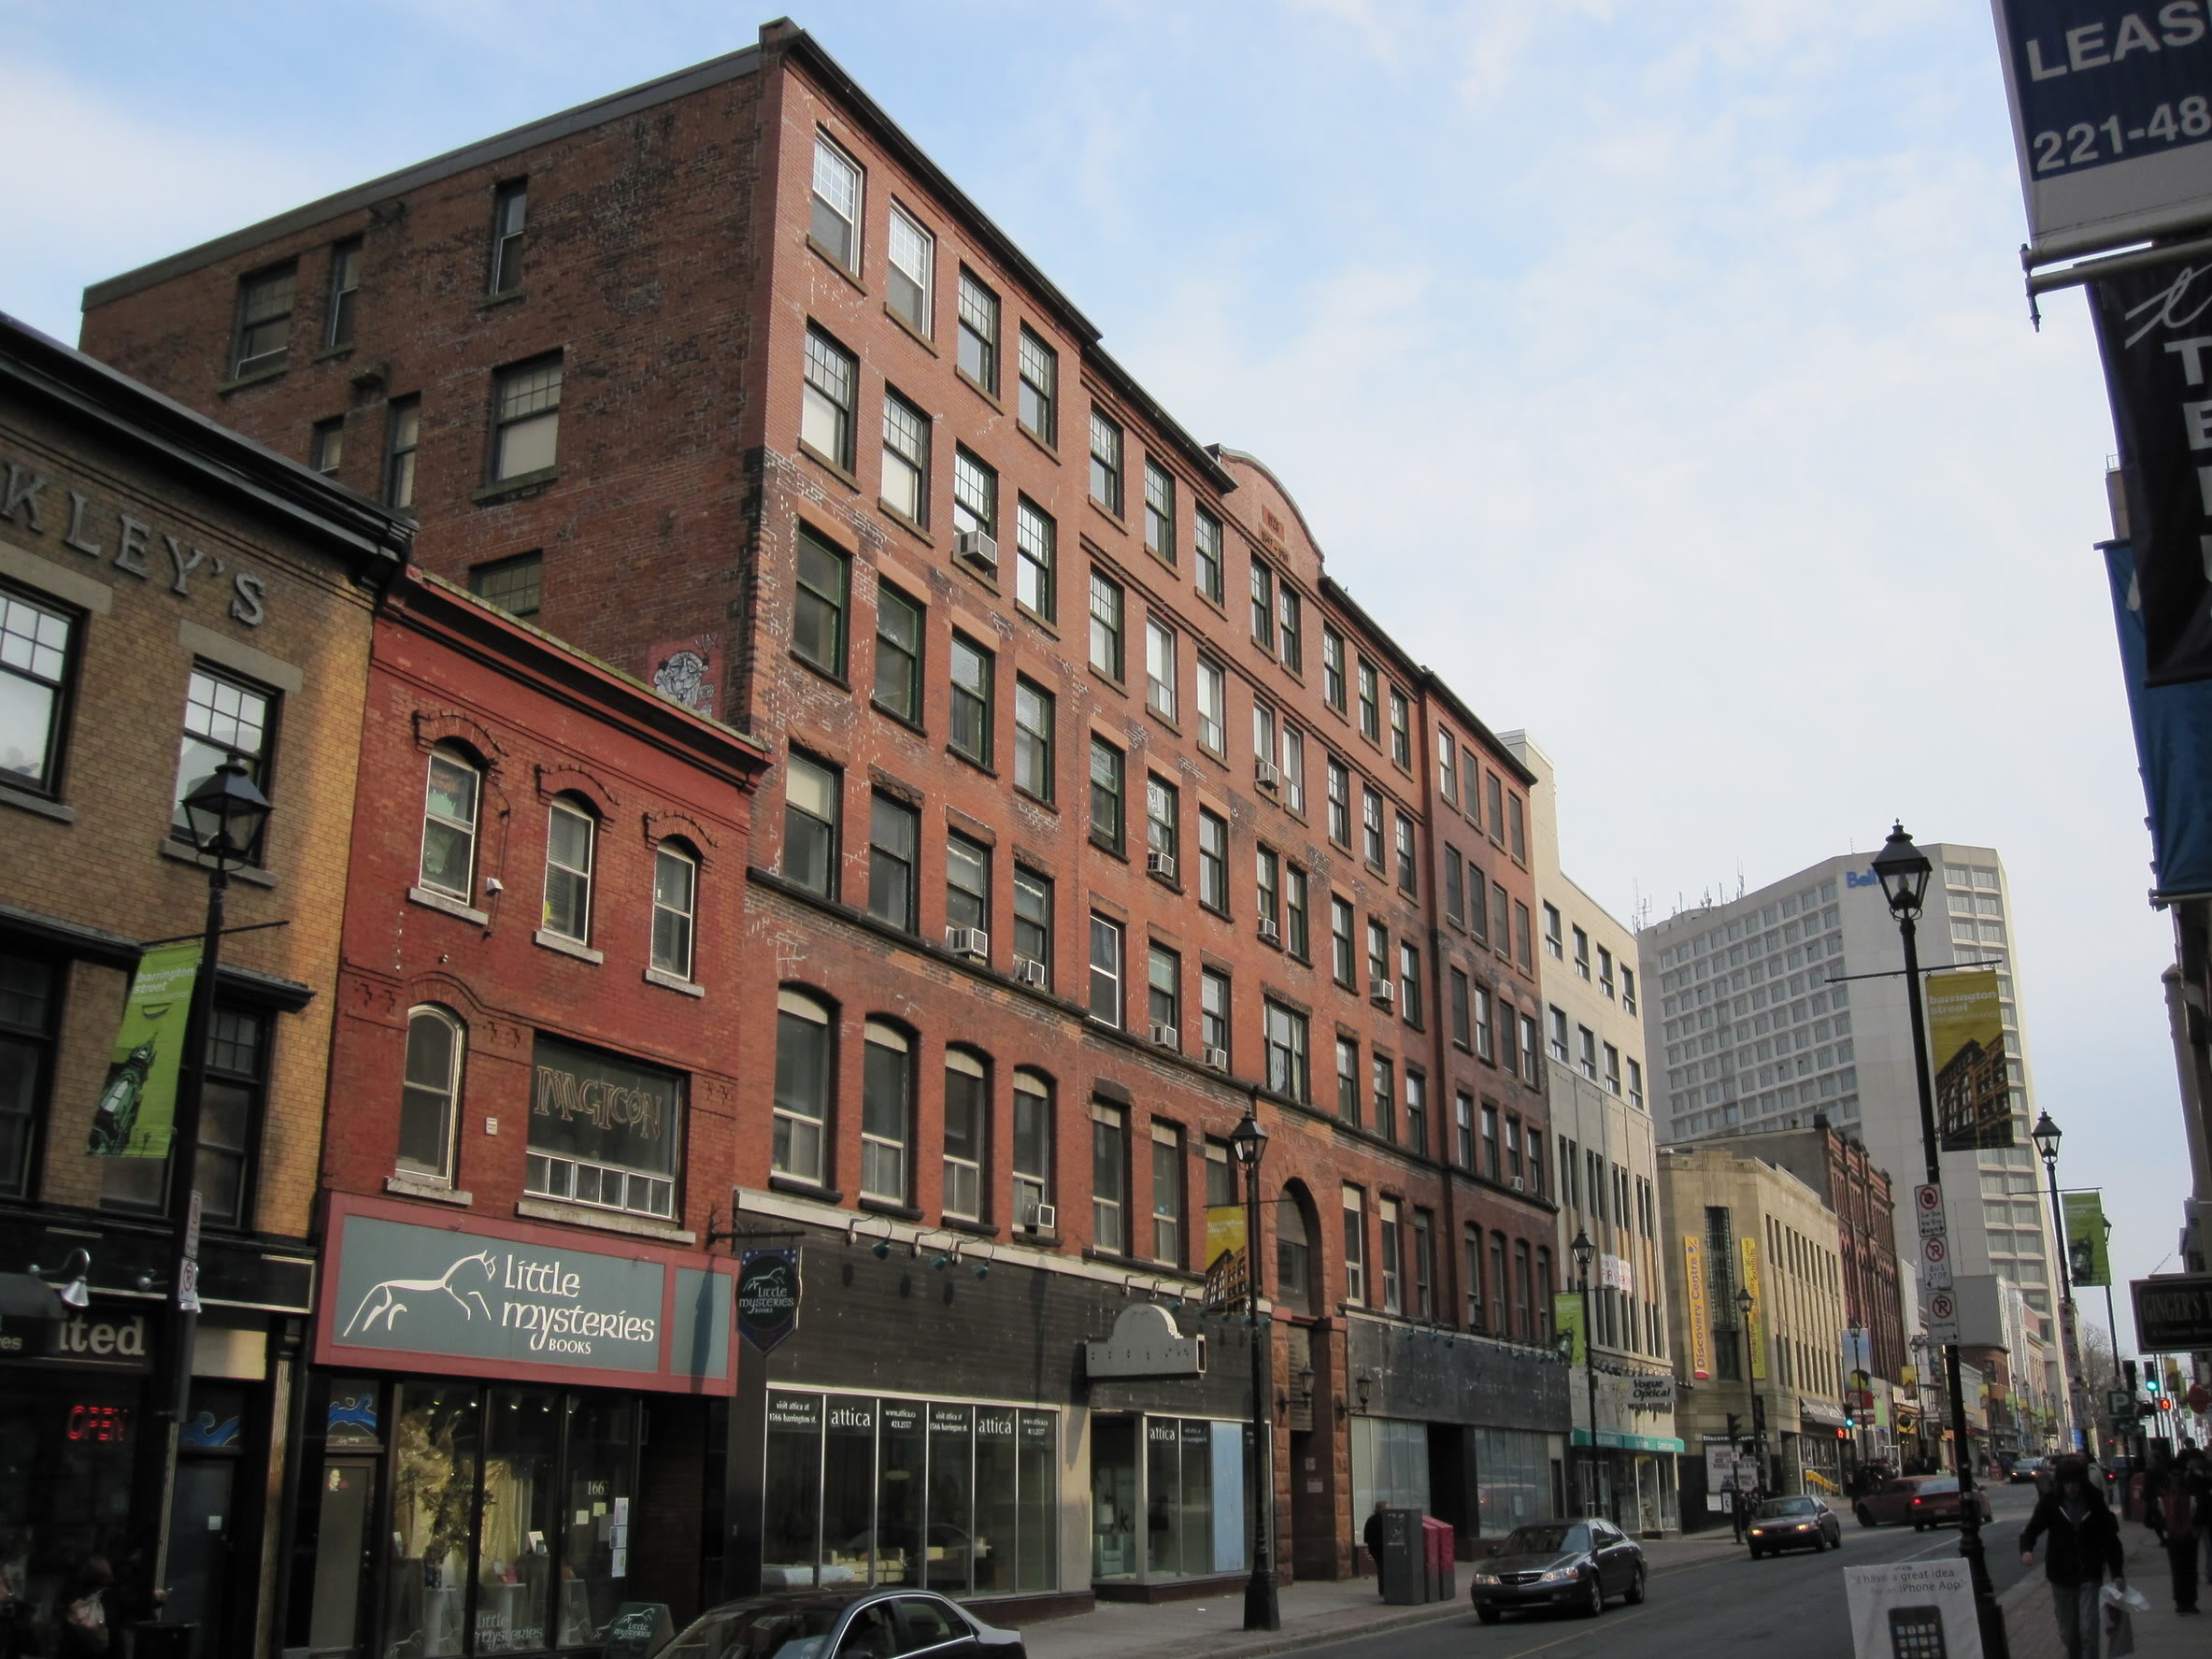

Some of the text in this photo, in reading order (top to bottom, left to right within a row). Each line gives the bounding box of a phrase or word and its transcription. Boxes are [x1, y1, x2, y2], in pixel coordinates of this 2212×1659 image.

[2026, 1, 2212, 82] LEAS
[2034, 95, 2212, 172] 221-48
[134, 981, 166, 994] street
[1928, 991, 1996, 1004] barrington
[1929, 1002, 1969, 1015] street
[1930, 1264, 1945, 1272] BUS
[505, 1254, 580, 1297] Little
[1929, 1271, 1947, 1280] STOP
[1691, 1257, 1705, 1368] Discovery Centre
[502, 1301, 655, 1351] mysteries
[0, 1337, 21, 1350] es
[549, 1338, 592, 1354] BOOKS
[1634, 1379, 1663, 1390] Vogue
[1634, 1388, 1671, 1401] Optical
[777, 1401, 788, 1409] visit
[789, 1402, 803, 1410] attica
[769, 1413, 782, 1422] 1566
[783, 1413, 810, 1424] barrington
[831, 1408, 871, 1426] attica
[978, 1417, 1012, 1435] attica
[1149, 1425, 1176, 1440] attica
[1863, 1575, 1888, 1584] have
[1901, 1570, 1929, 1581] great
[1932, 1568, 1955, 1579] idea
[1899, 1581, 1935, 1594] iPhone
